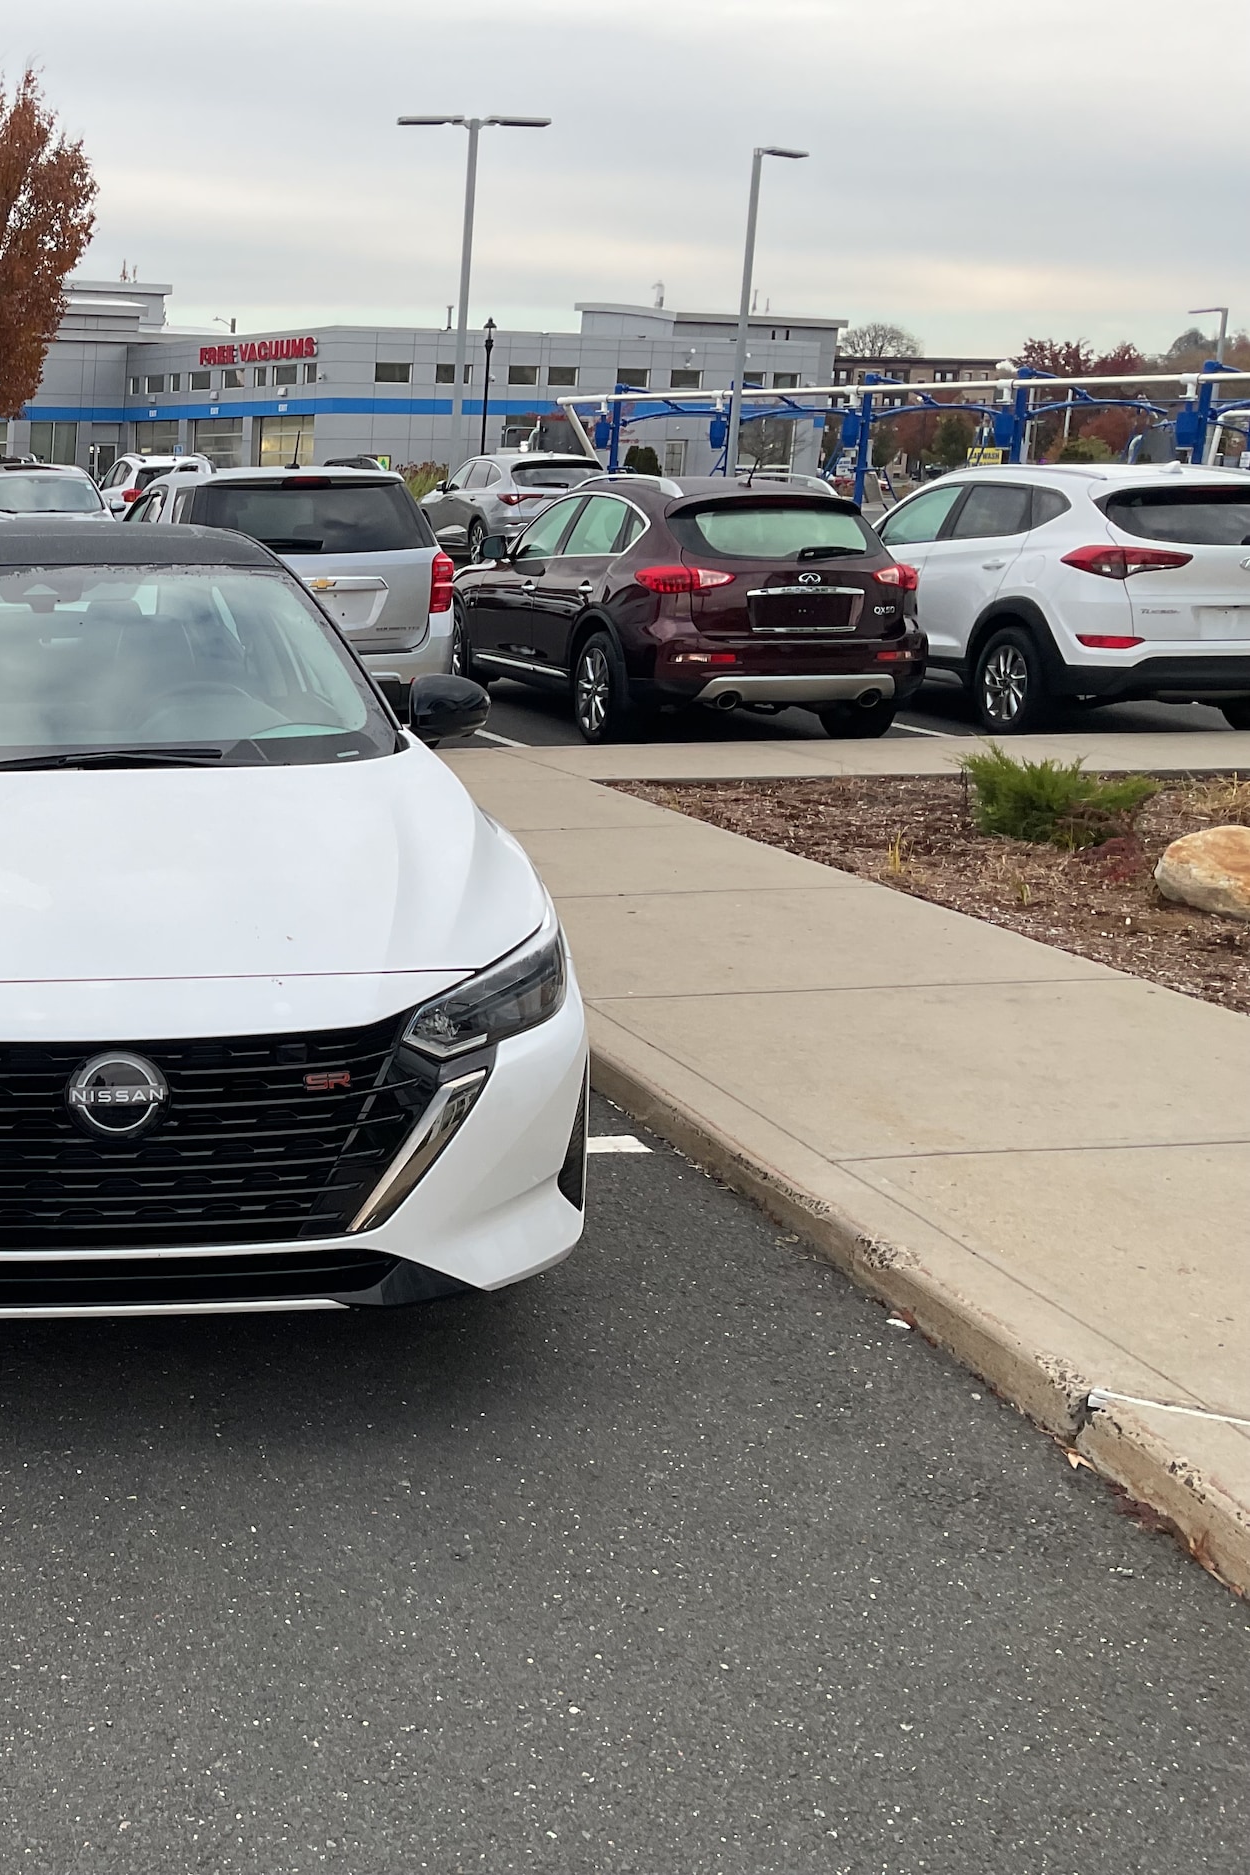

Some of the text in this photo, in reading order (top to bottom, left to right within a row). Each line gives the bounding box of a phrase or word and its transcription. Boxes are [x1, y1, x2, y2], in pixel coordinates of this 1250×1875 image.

[199, 336, 318, 366] FREE VACUUMS
[873, 606, 896, 615] QX50
[304, 1072, 351, 1091] SR
[71, 1088, 164, 1103] NISSAN
